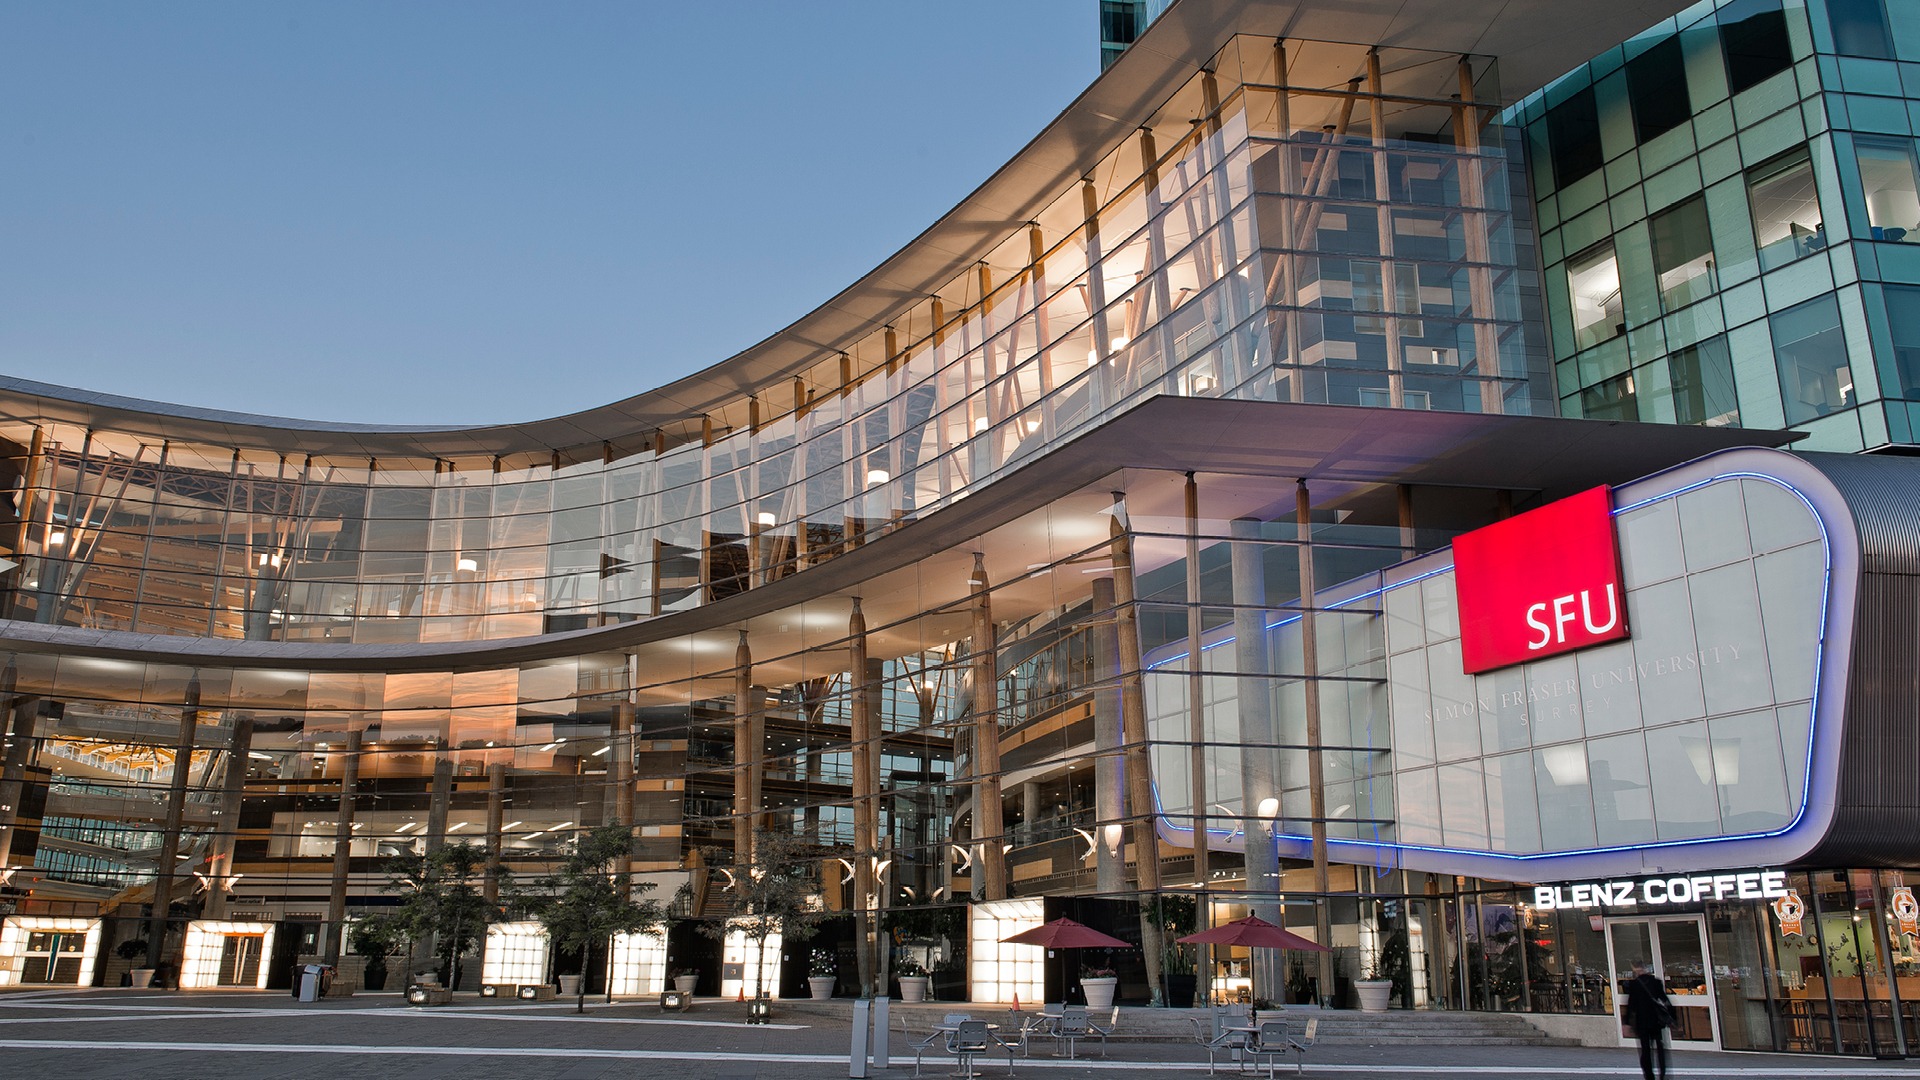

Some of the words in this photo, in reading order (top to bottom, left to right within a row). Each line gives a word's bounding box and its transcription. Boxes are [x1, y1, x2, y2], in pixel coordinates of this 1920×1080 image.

[1526, 583, 1617, 650] SFU
[1424, 697, 1491, 724] SIMON
[1501, 678, 1578, 708] FRASER
[1591, 642, 1742, 689] UNIVERSITY
[1520, 695, 1612, 726] SURREY
[1534, 881, 1636, 910] BLENZ
[1643, 871, 1789, 905] COFFEE
